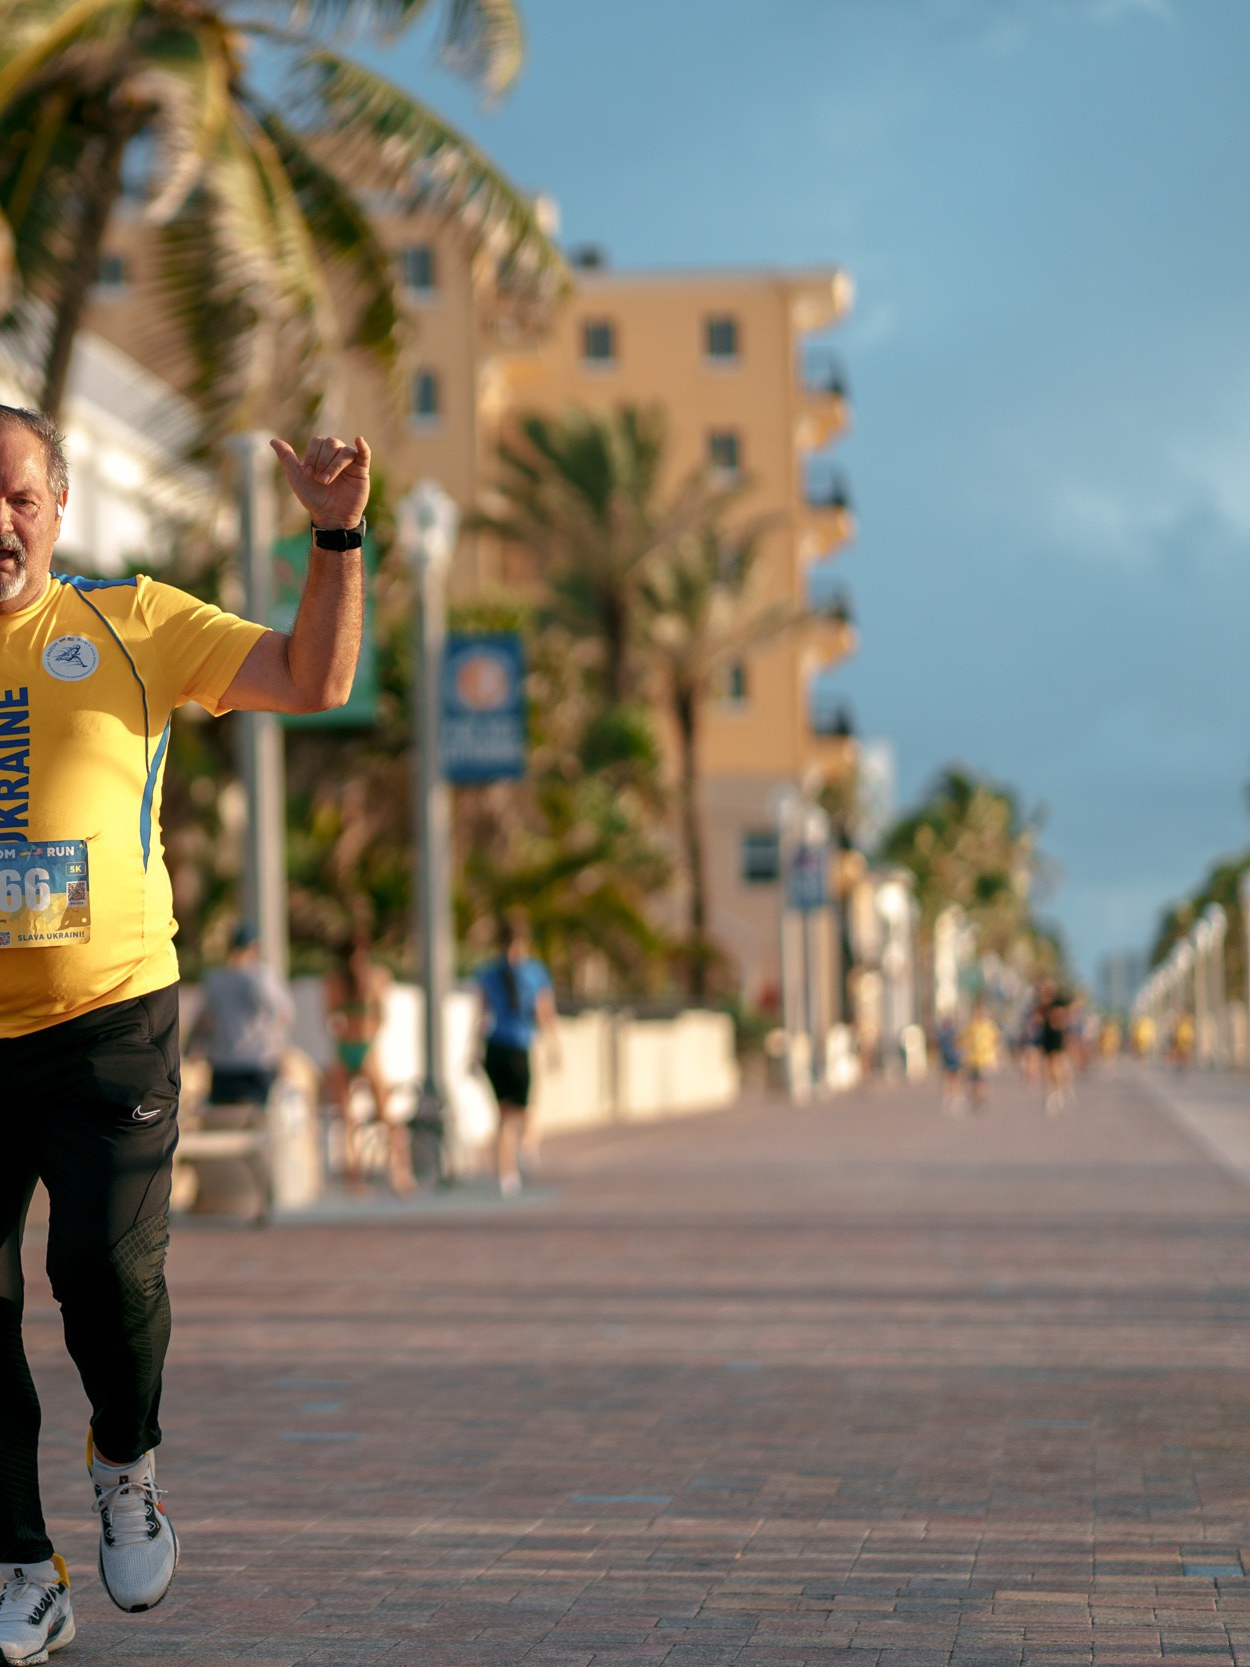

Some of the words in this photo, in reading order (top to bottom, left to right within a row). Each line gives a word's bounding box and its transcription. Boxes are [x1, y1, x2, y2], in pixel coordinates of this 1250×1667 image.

[47, 846, 74, 857] RUN
[69, 865, 82, 873] 5K
[17, 934, 44, 942] SLAVA
[46, 931, 85, 940] UKRAINI!
